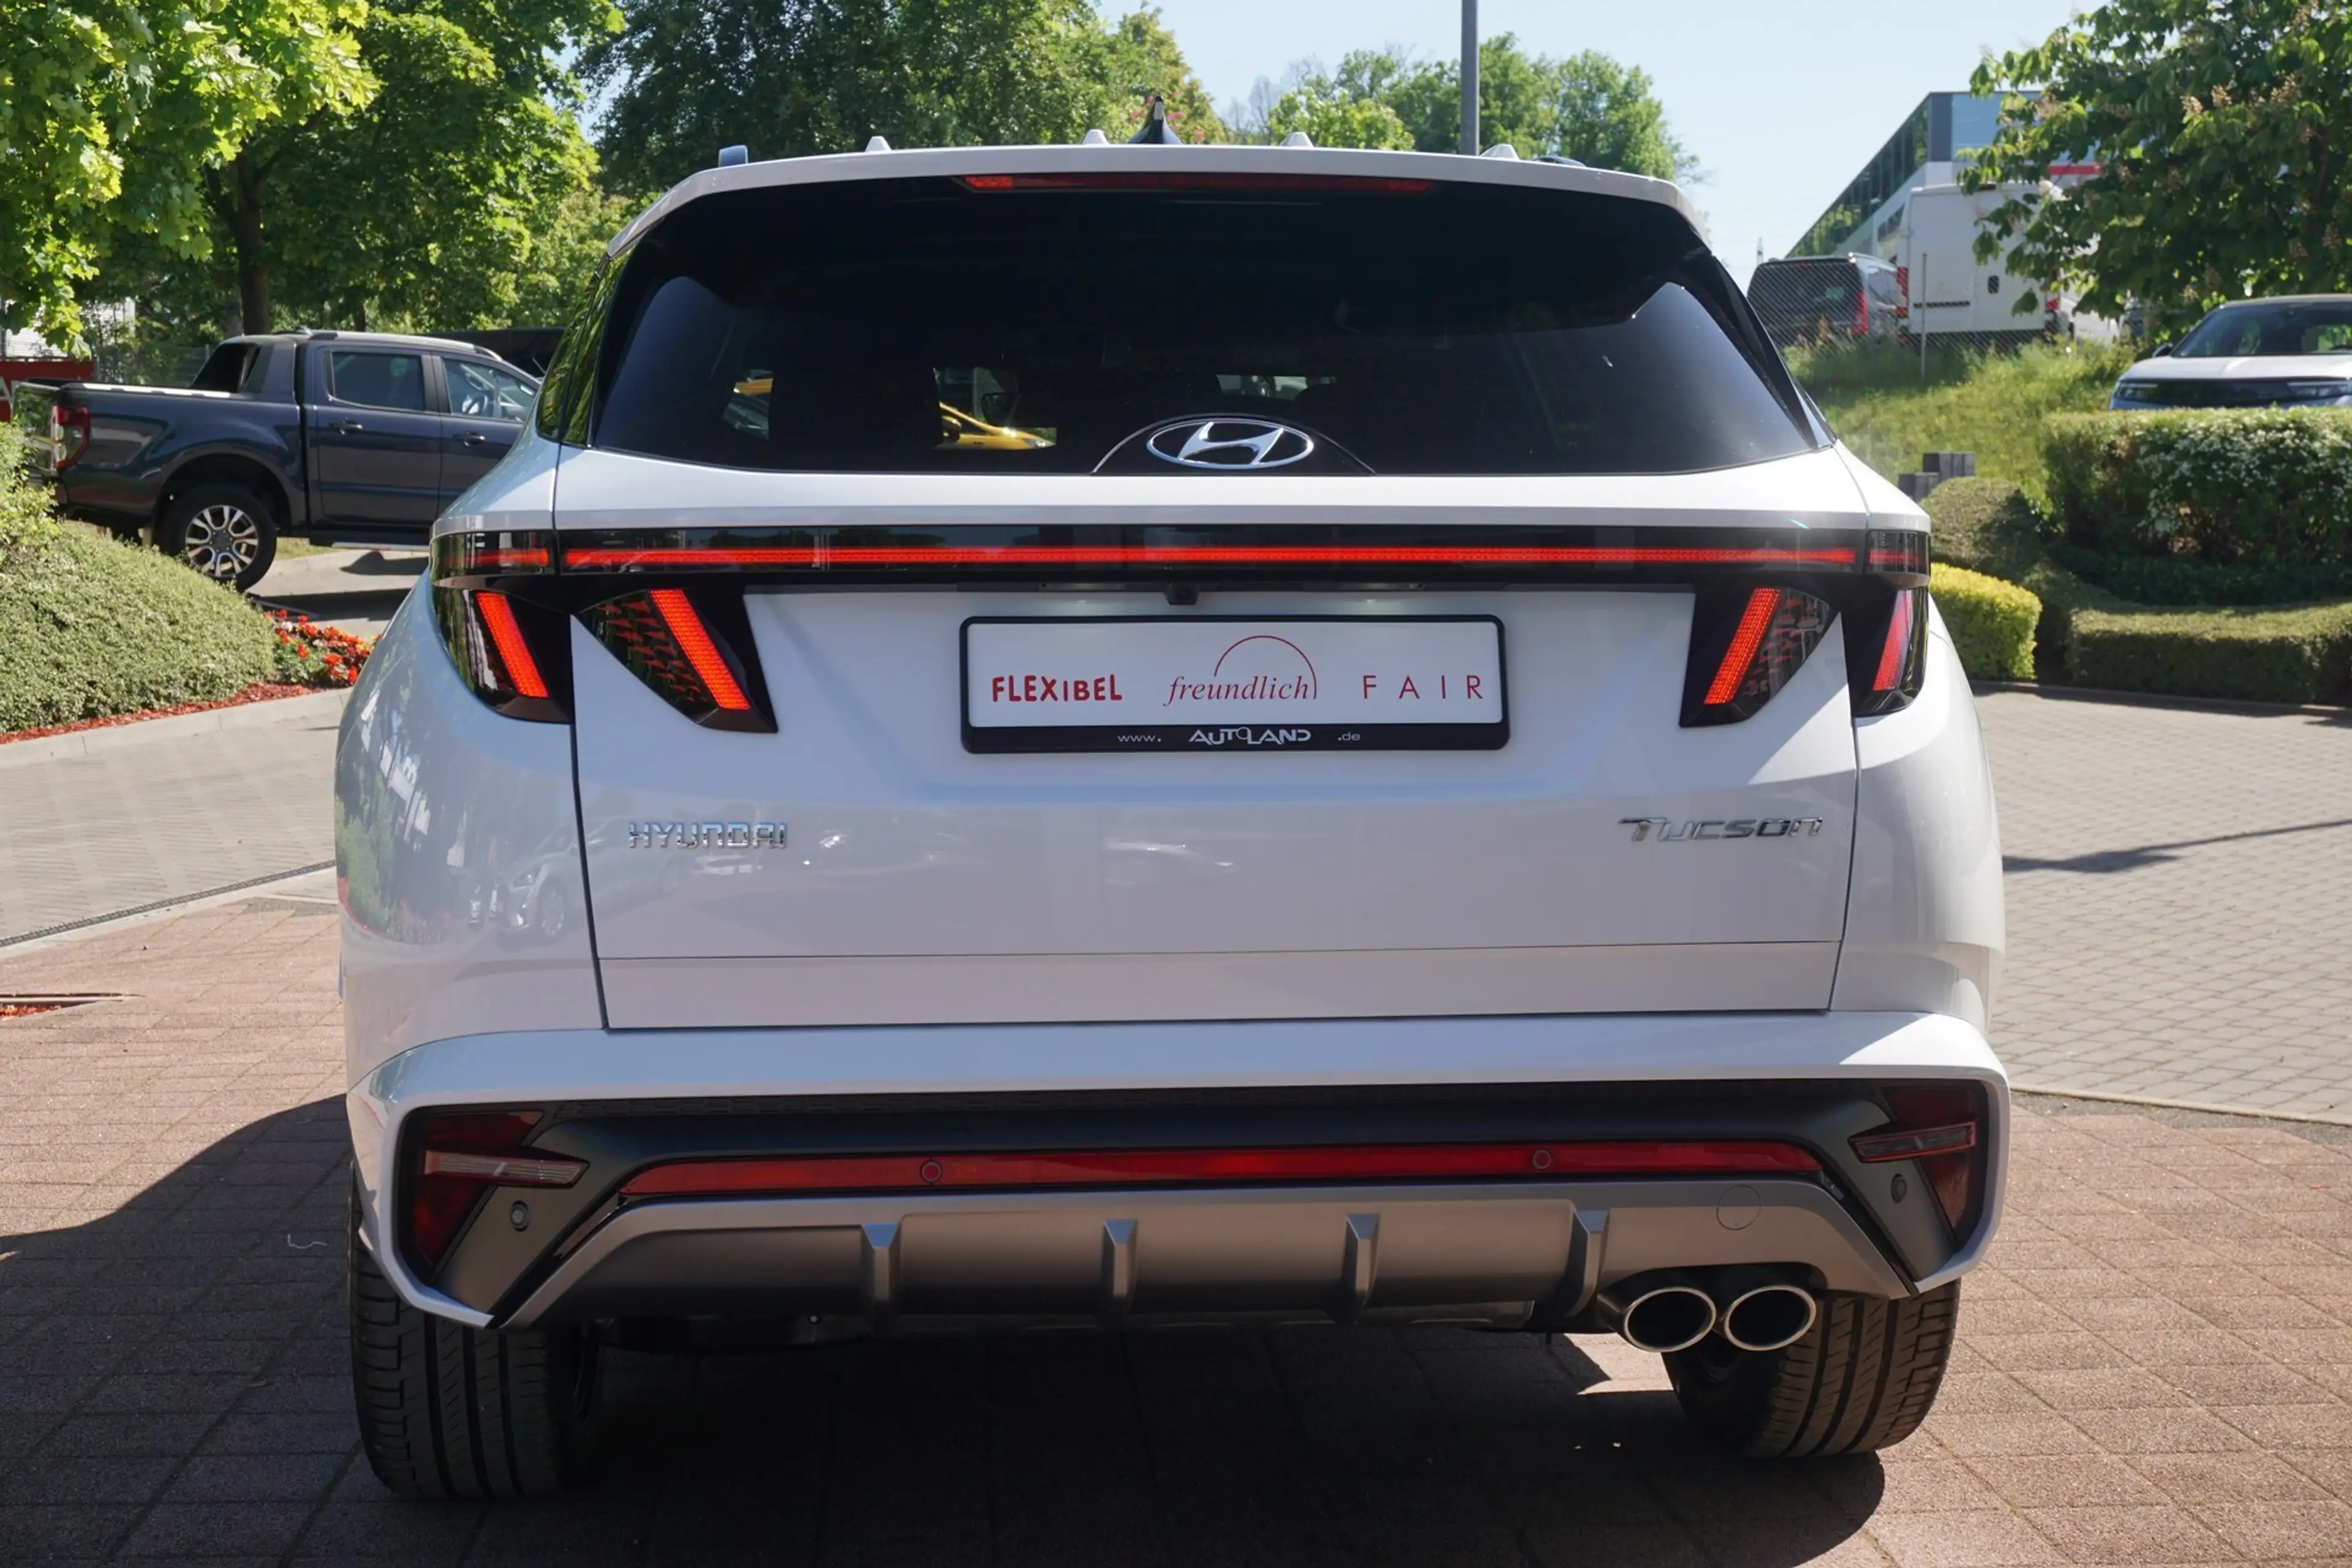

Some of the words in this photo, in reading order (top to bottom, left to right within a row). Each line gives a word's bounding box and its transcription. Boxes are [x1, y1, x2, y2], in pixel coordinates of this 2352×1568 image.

[992, 674, 1123, 703] FLEXIBEL
[1163, 675, 1310, 707] freundlich
[1363, 674, 1483, 699] FAIR
[1118, 734, 1162, 743] www.
[1188, 726, 1312, 746] AUTOLAND
[1337, 731, 1361, 742] .de
[628, 821, 788, 849] HYUNDAI
[1617, 816, 1823, 843] TUCSON
